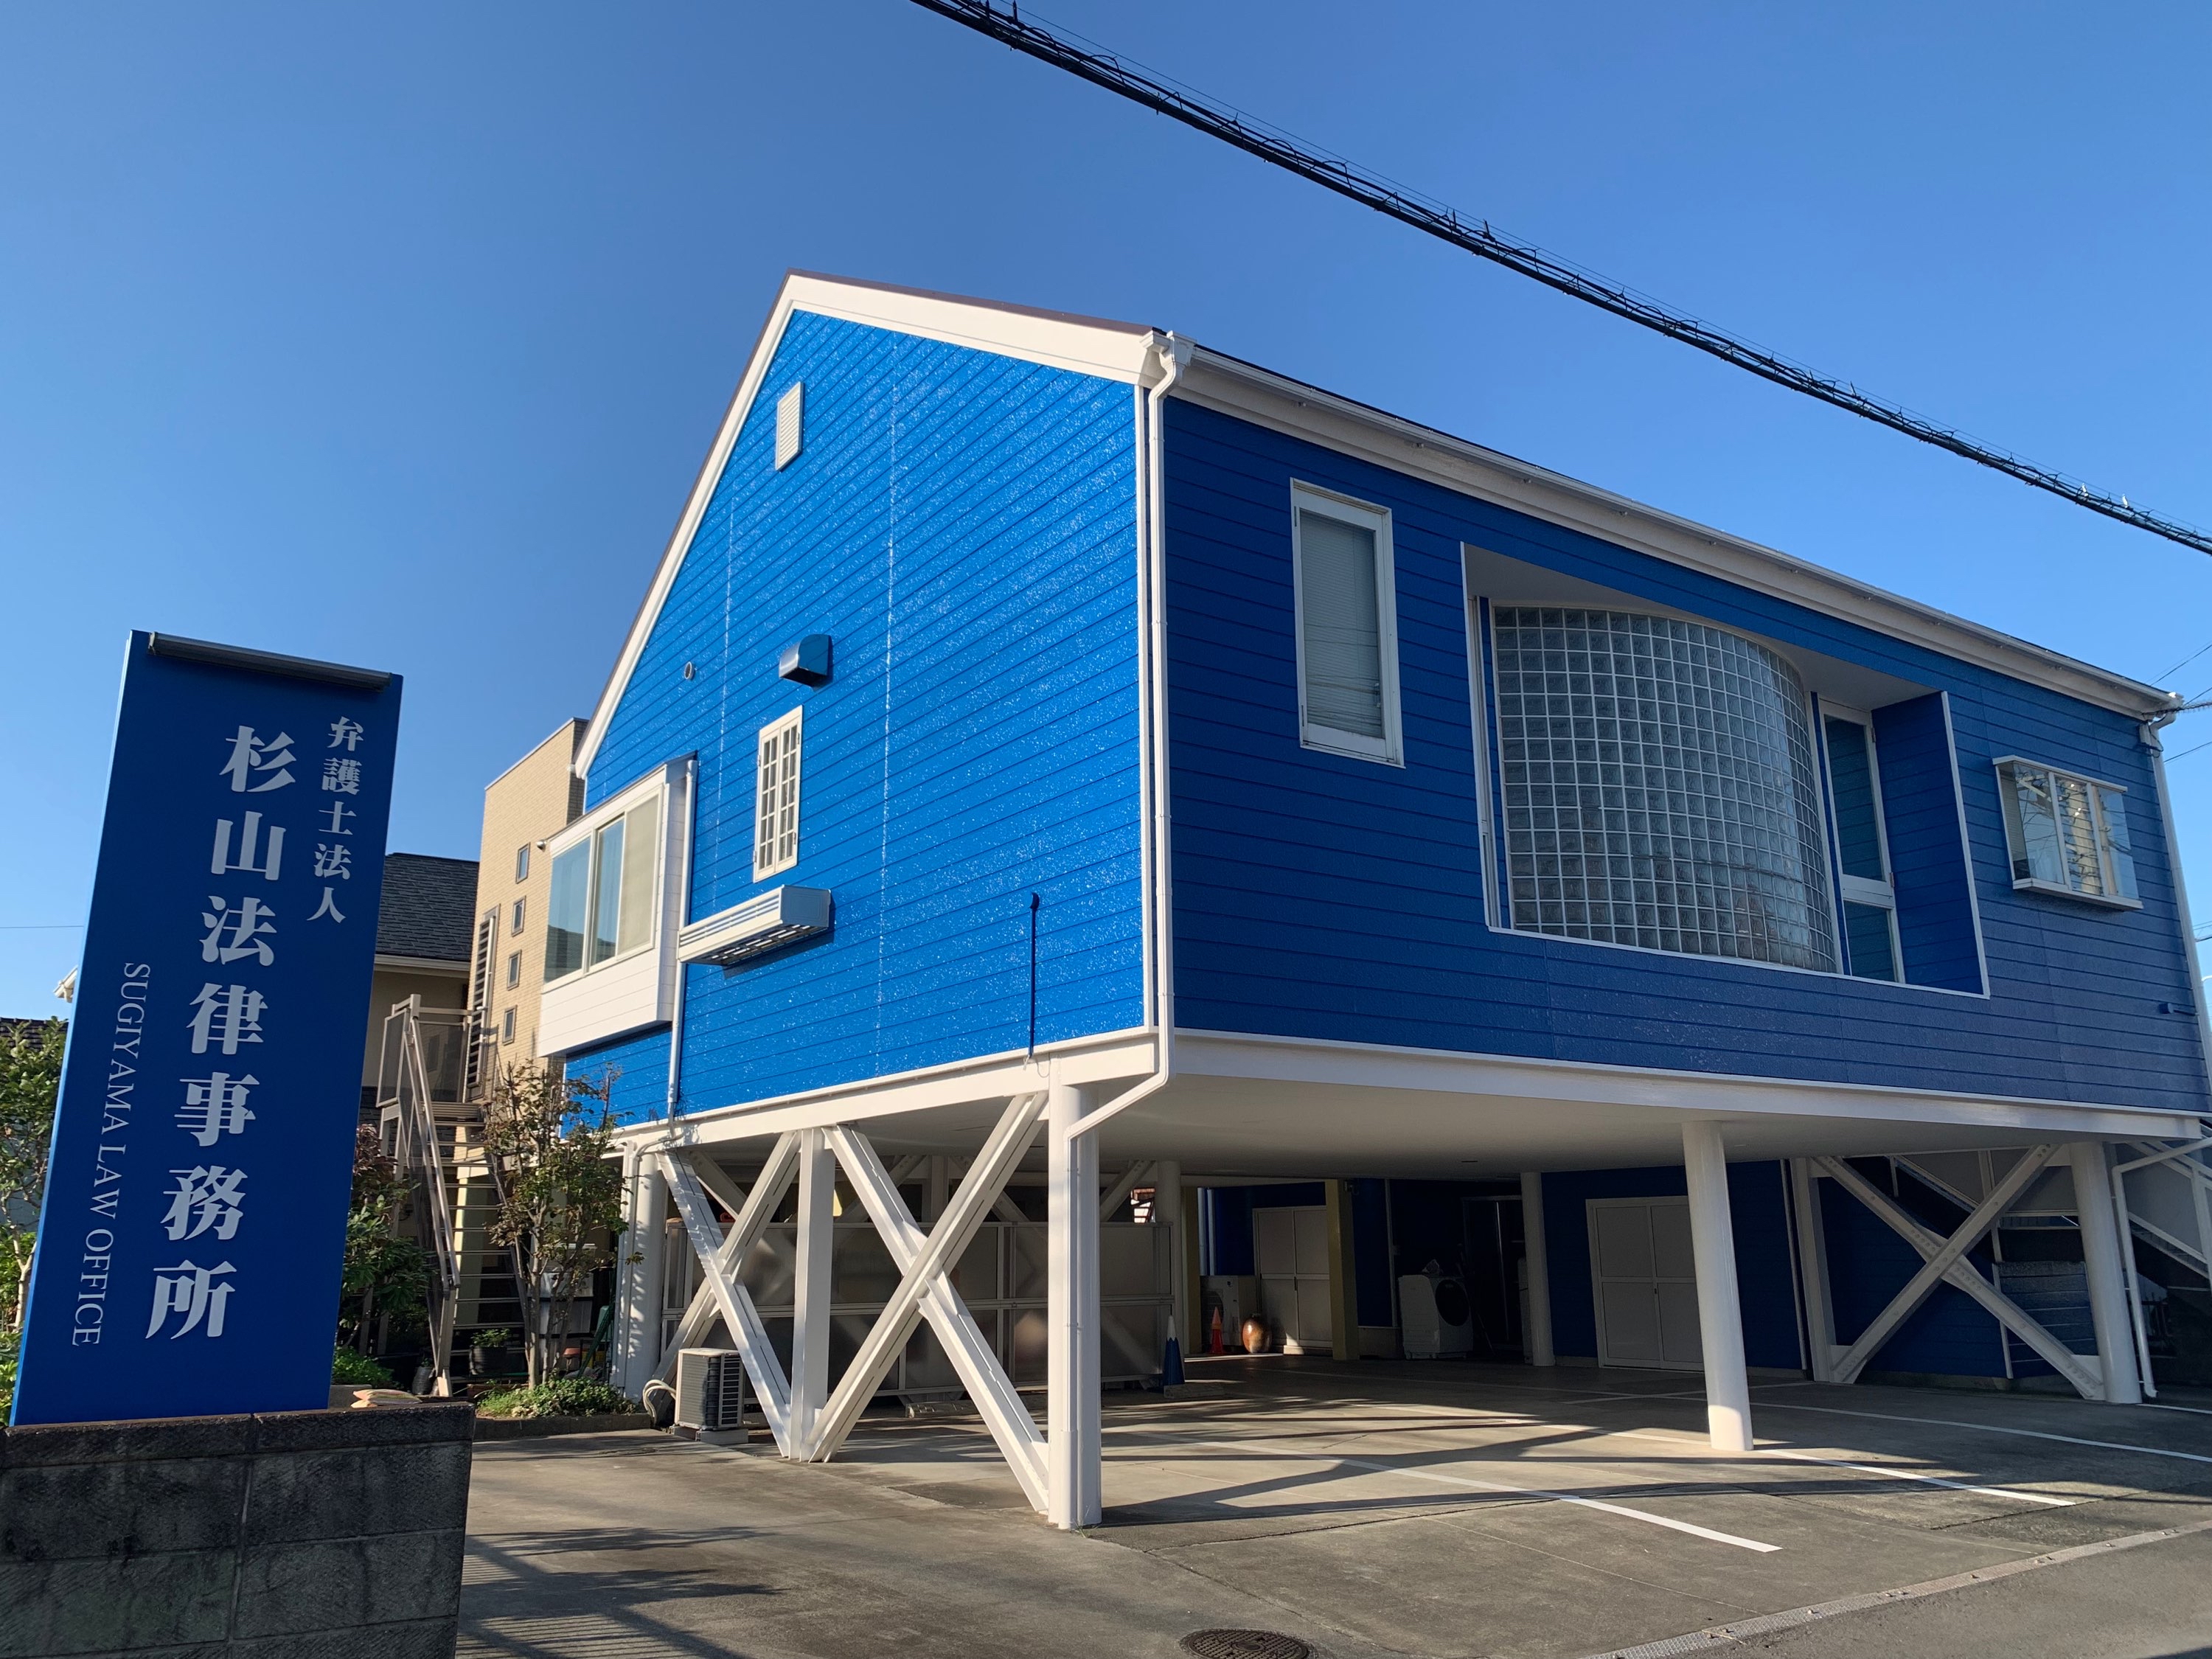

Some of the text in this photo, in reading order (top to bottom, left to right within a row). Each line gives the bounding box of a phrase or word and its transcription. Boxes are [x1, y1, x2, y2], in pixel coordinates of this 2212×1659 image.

[307, 716, 364, 923] 弁護士法人
[72, 962, 150, 1346] SUGIYAMA LAW OFFICE
[145, 725, 296, 1340] 杉山法律事務所
